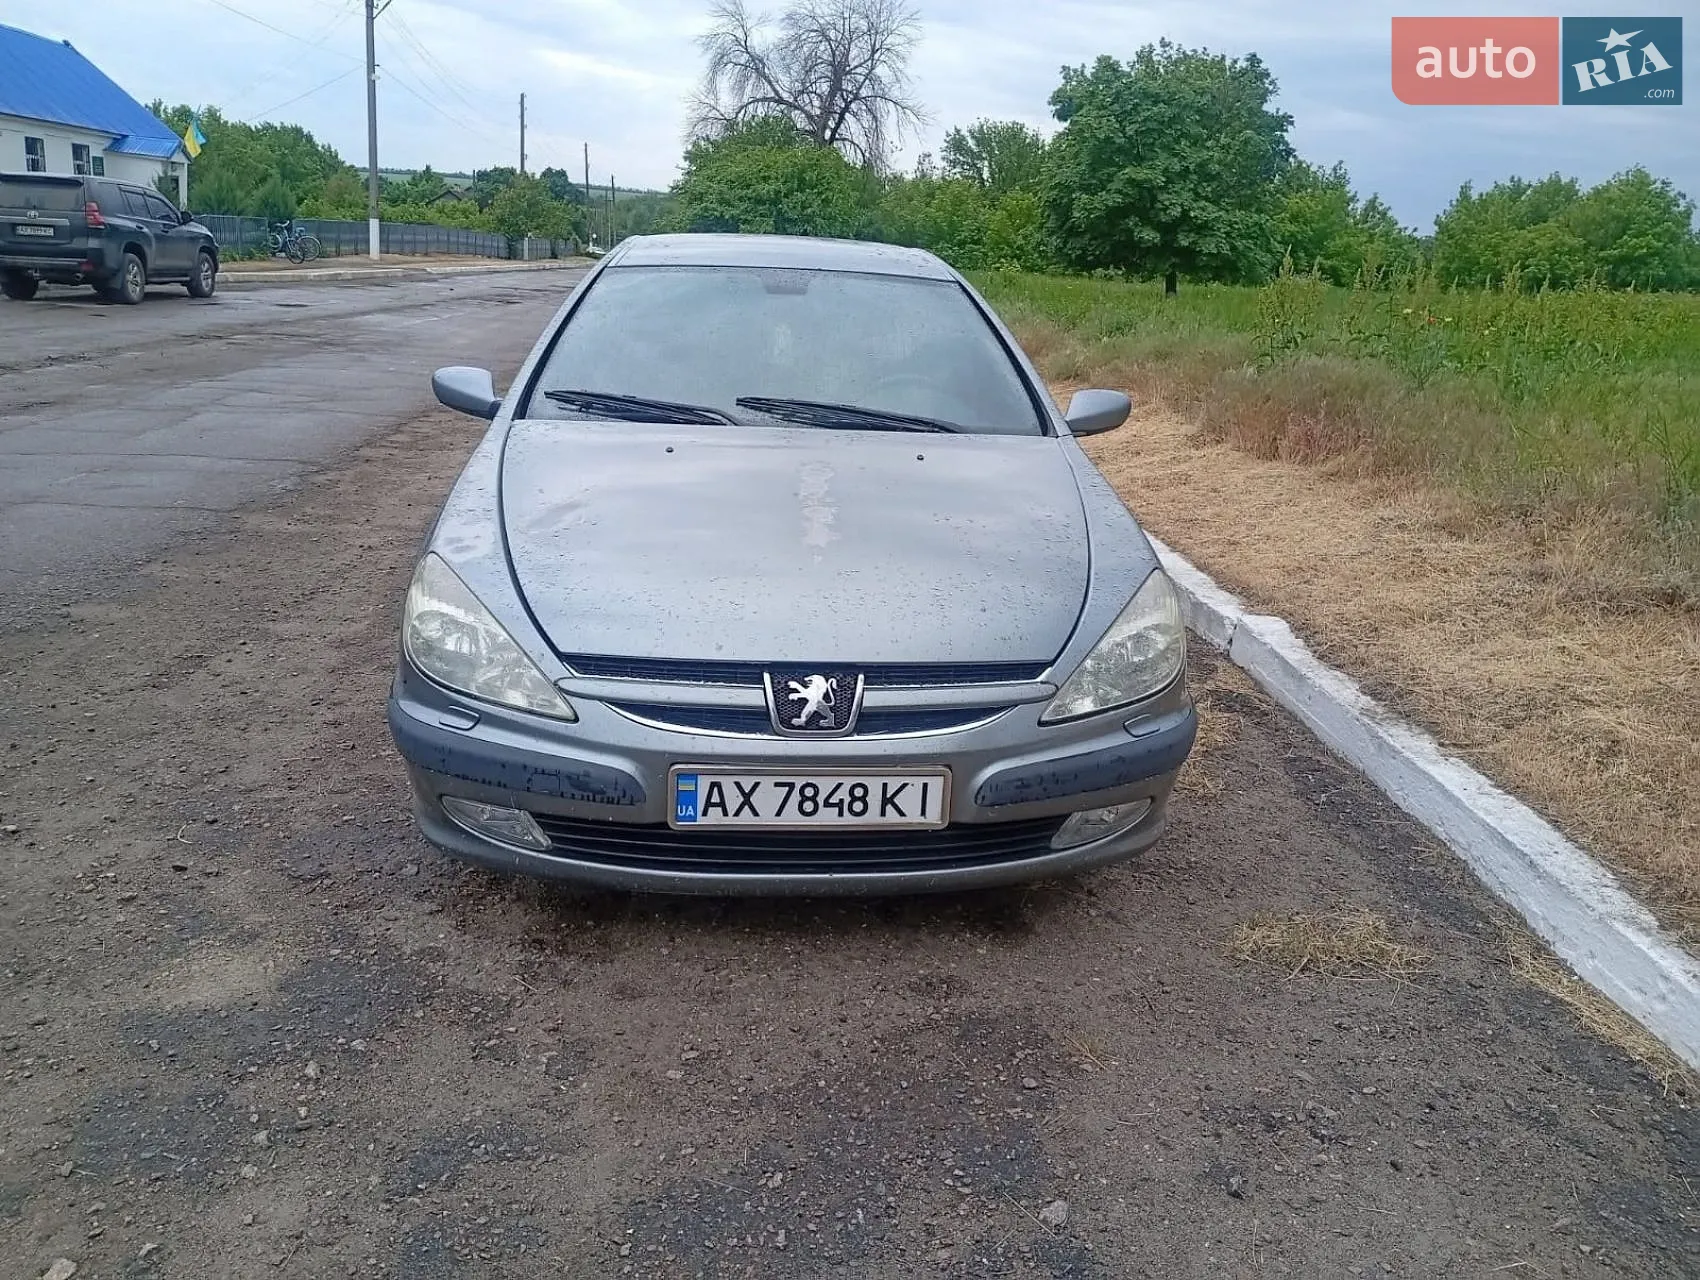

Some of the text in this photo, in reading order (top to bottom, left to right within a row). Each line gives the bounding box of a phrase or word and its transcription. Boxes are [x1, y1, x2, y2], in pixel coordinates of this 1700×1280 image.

[677, 805, 695, 816] UA
[701, 781, 929, 818] AX 7848 KI
